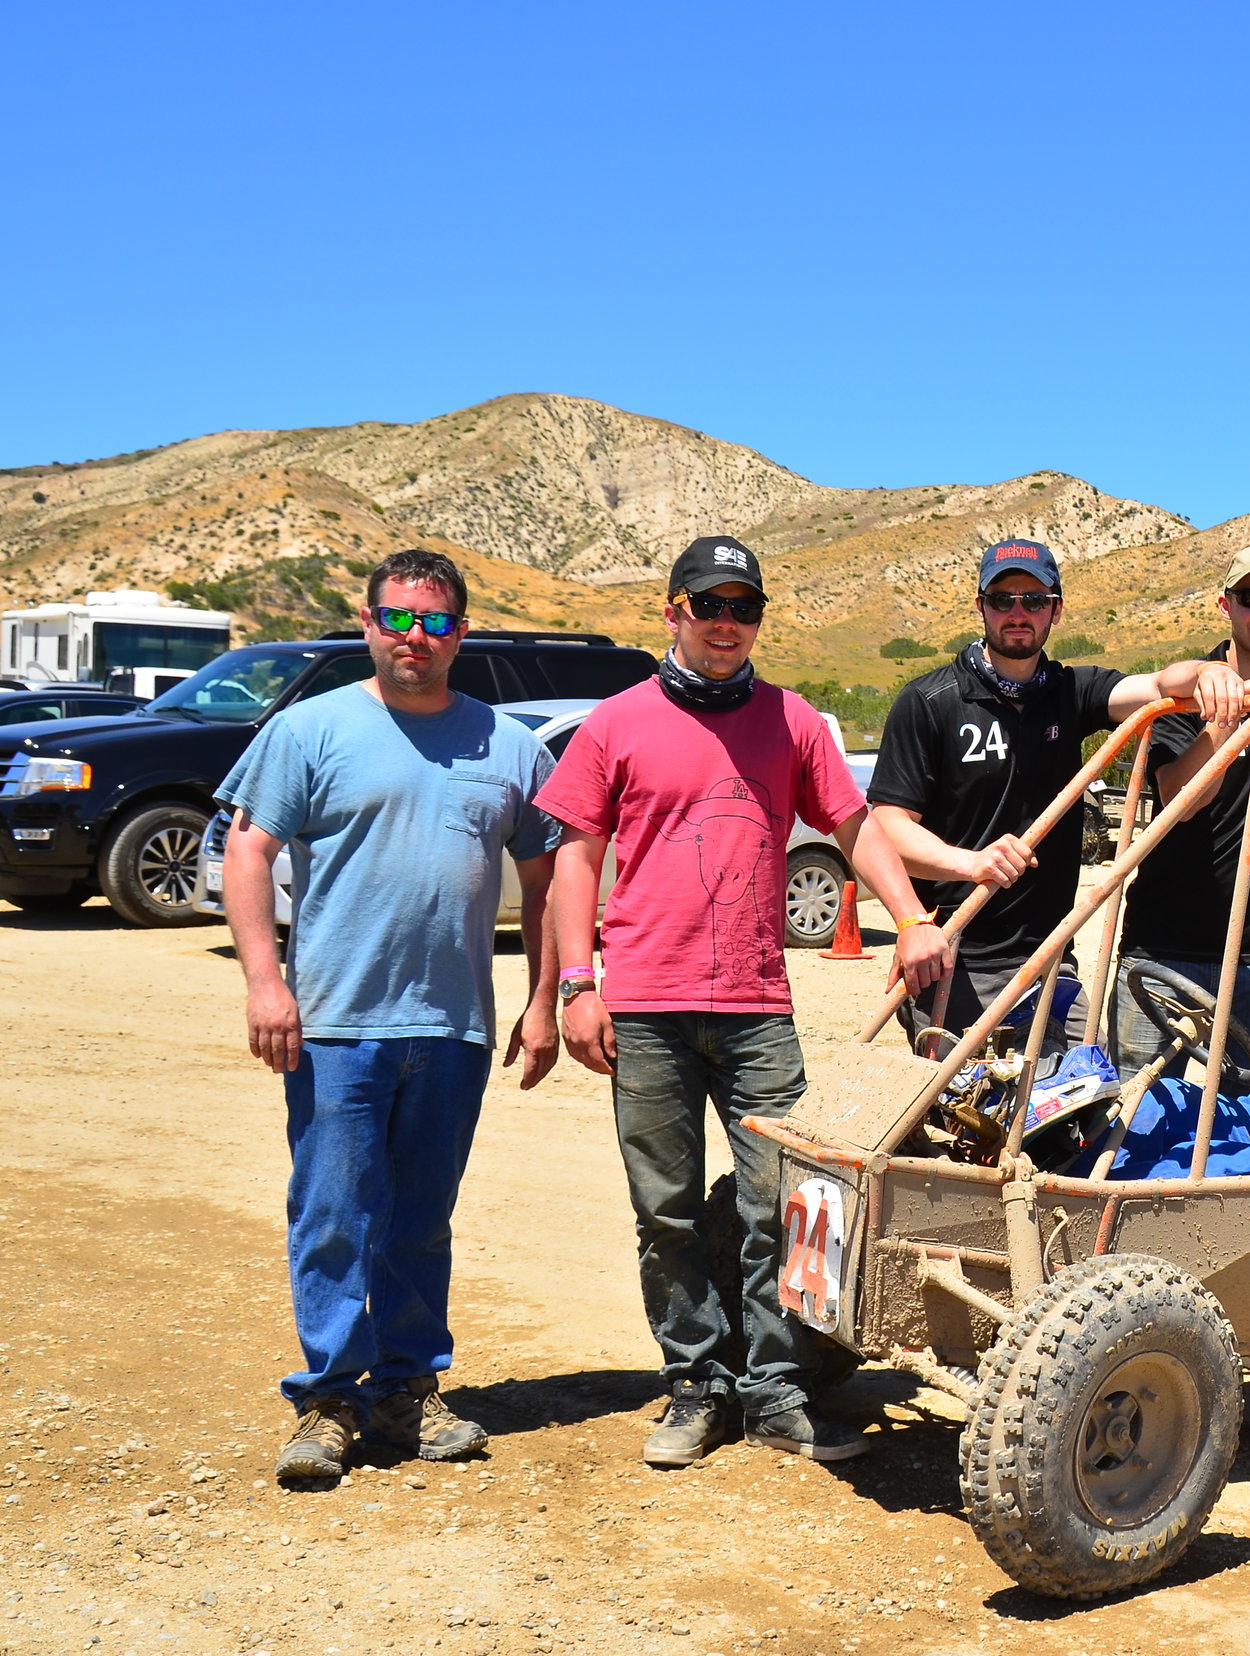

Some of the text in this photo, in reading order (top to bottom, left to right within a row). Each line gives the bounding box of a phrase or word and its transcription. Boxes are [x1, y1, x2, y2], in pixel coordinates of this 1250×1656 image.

[713, 545, 748, 568] SAE
[959, 720, 1009, 763] 24
[778, 1189, 829, 1323] 24
[1091, 1511, 1188, 1562] MAXXIS
